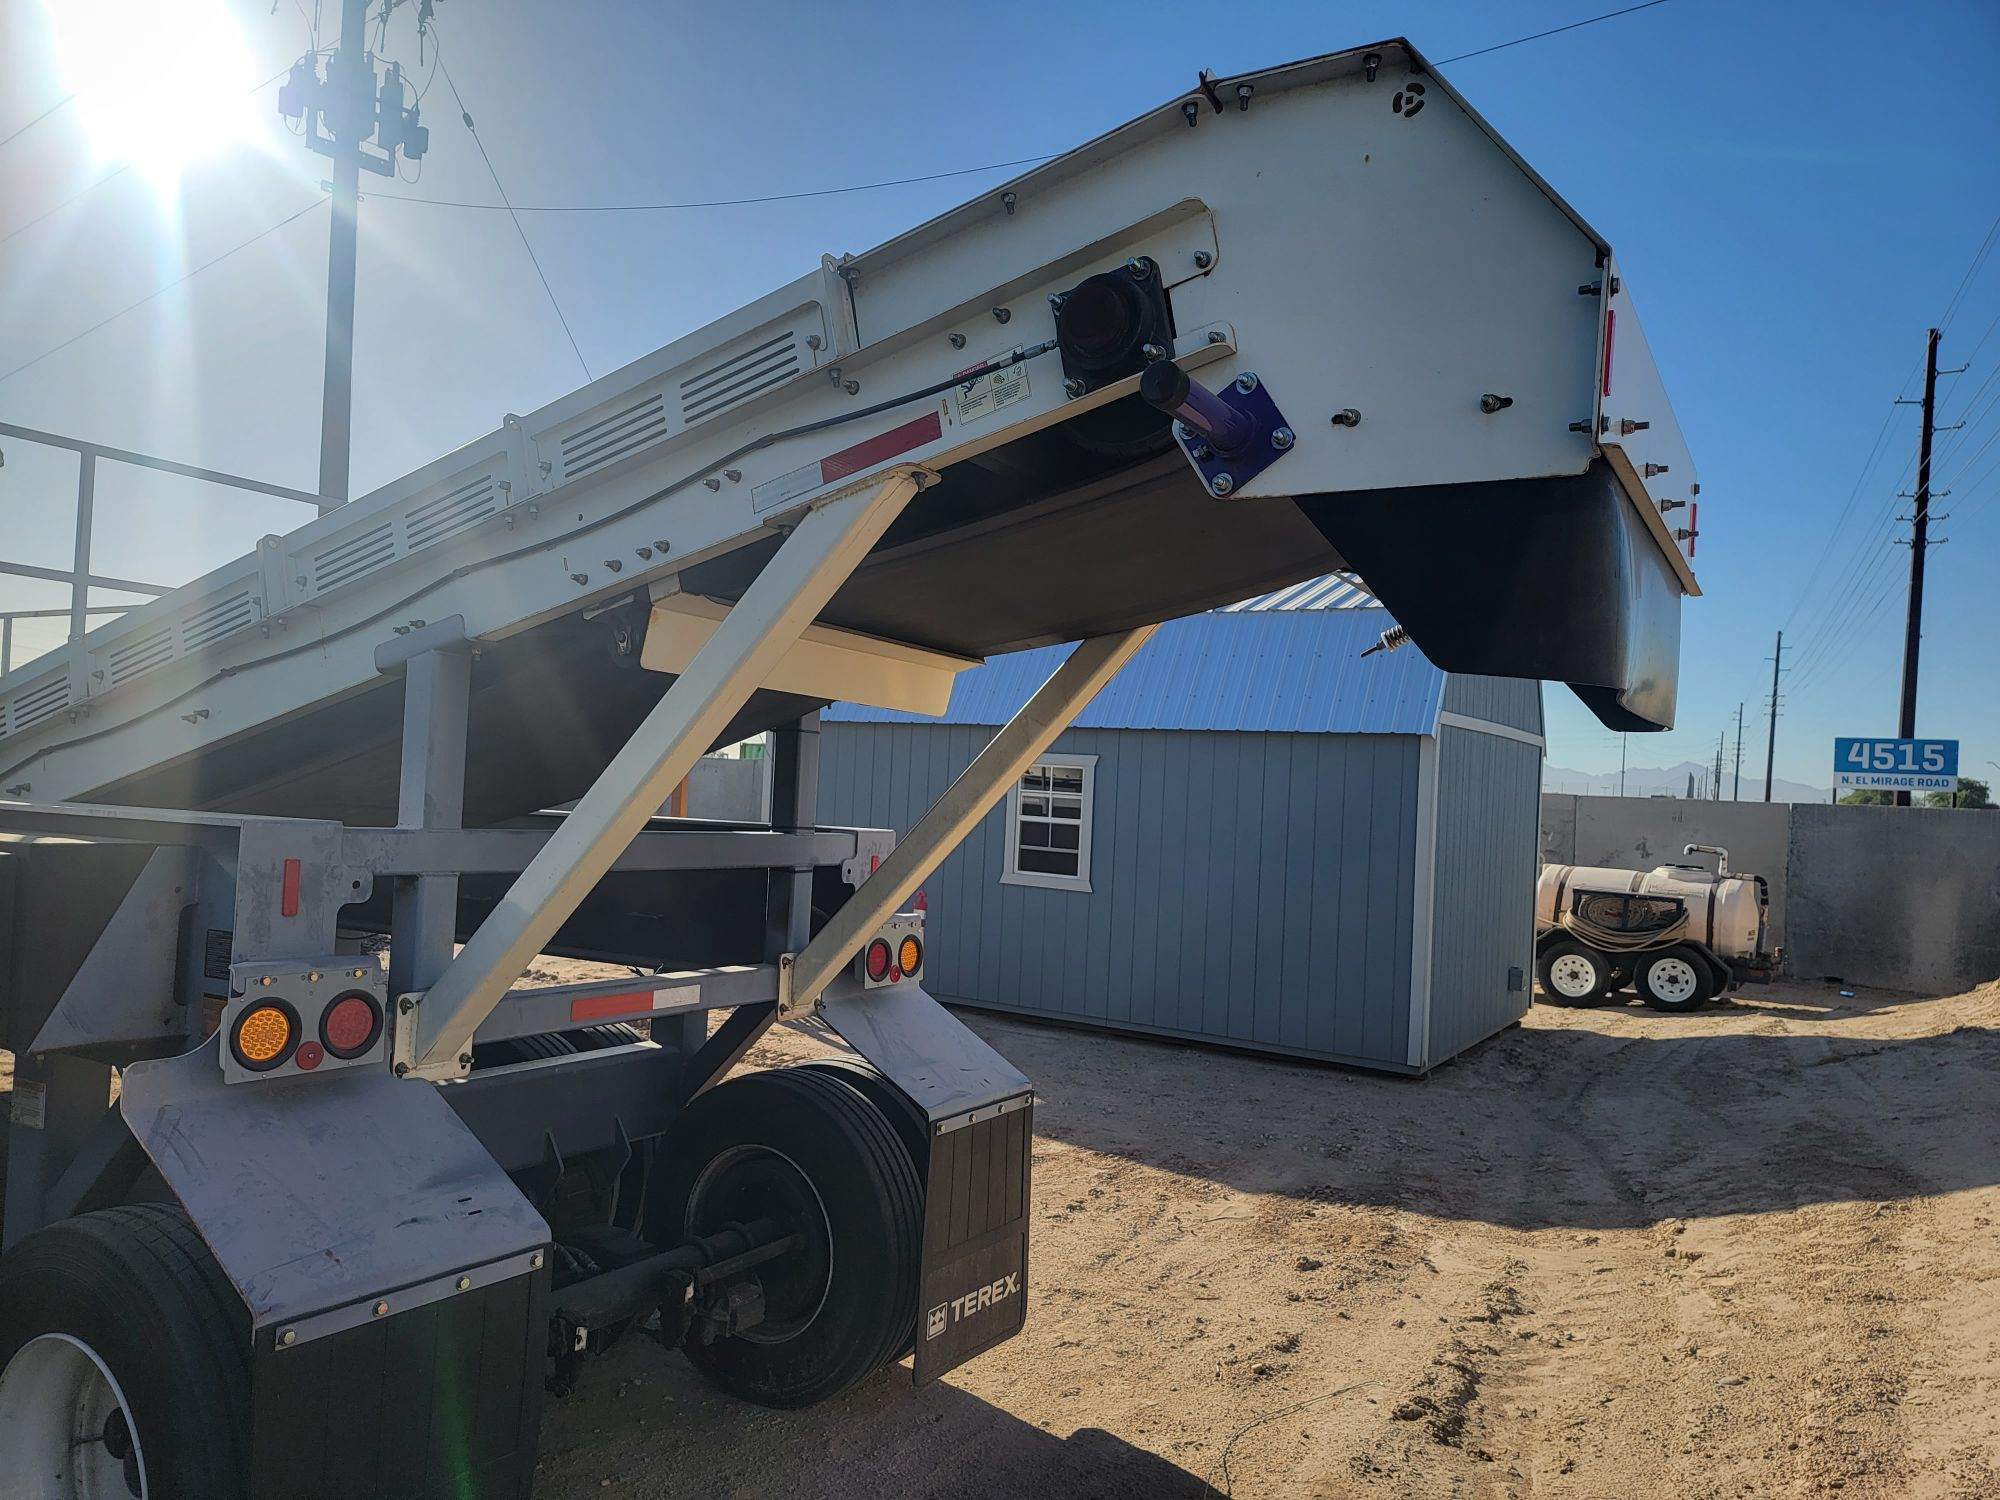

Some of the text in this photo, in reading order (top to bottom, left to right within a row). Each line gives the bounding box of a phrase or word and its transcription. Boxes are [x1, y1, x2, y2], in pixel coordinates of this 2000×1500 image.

[1848, 742, 1945, 772] 4515
[1841, 776, 1949, 787] N. EL MIRAGE ROAD
[951, 1271, 1018, 1322] TEREX
